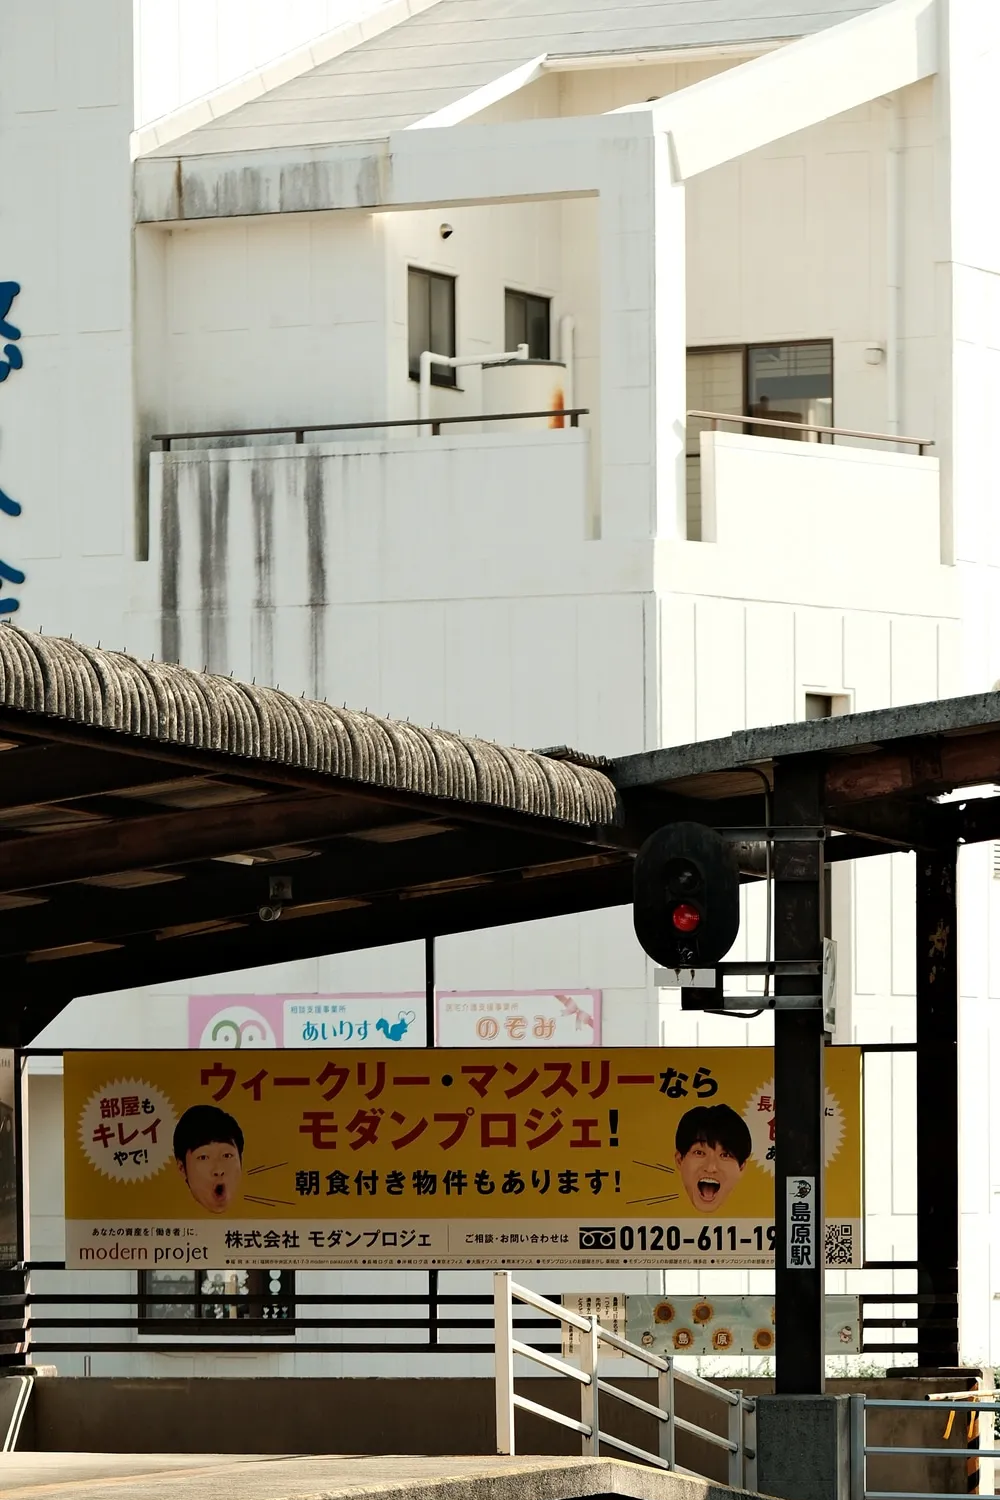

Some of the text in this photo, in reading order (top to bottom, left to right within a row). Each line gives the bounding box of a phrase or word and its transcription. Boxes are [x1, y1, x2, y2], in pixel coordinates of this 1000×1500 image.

[290, 1005, 346, 1014] 相談支援事業所
[302, 1020, 372, 1041] あいりす
[475, 1015, 556, 1041] のぞみ
[200, 1060, 719, 1102] ウィークリー・マンスリーなら
[99, 1096, 155, 1118] 部屋も
[92, 1118, 161, 1148] キレイ
[299, 1106, 619, 1151] モダンプロジェ!
[113, 1149, 149, 1166] やで!
[295, 1169, 621, 1195] 朝食付き物件もあります!
[224, 1230, 432, 1248] 株式会社 モダンプロジェ
[464, 1233, 570, 1244] ご相談・お問い合わせは
[620, 1225, 776, 1251] 0120-611-19
[790, 1201, 812, 1266] 島原駅
[79, 1242, 208, 1263] modern projet
